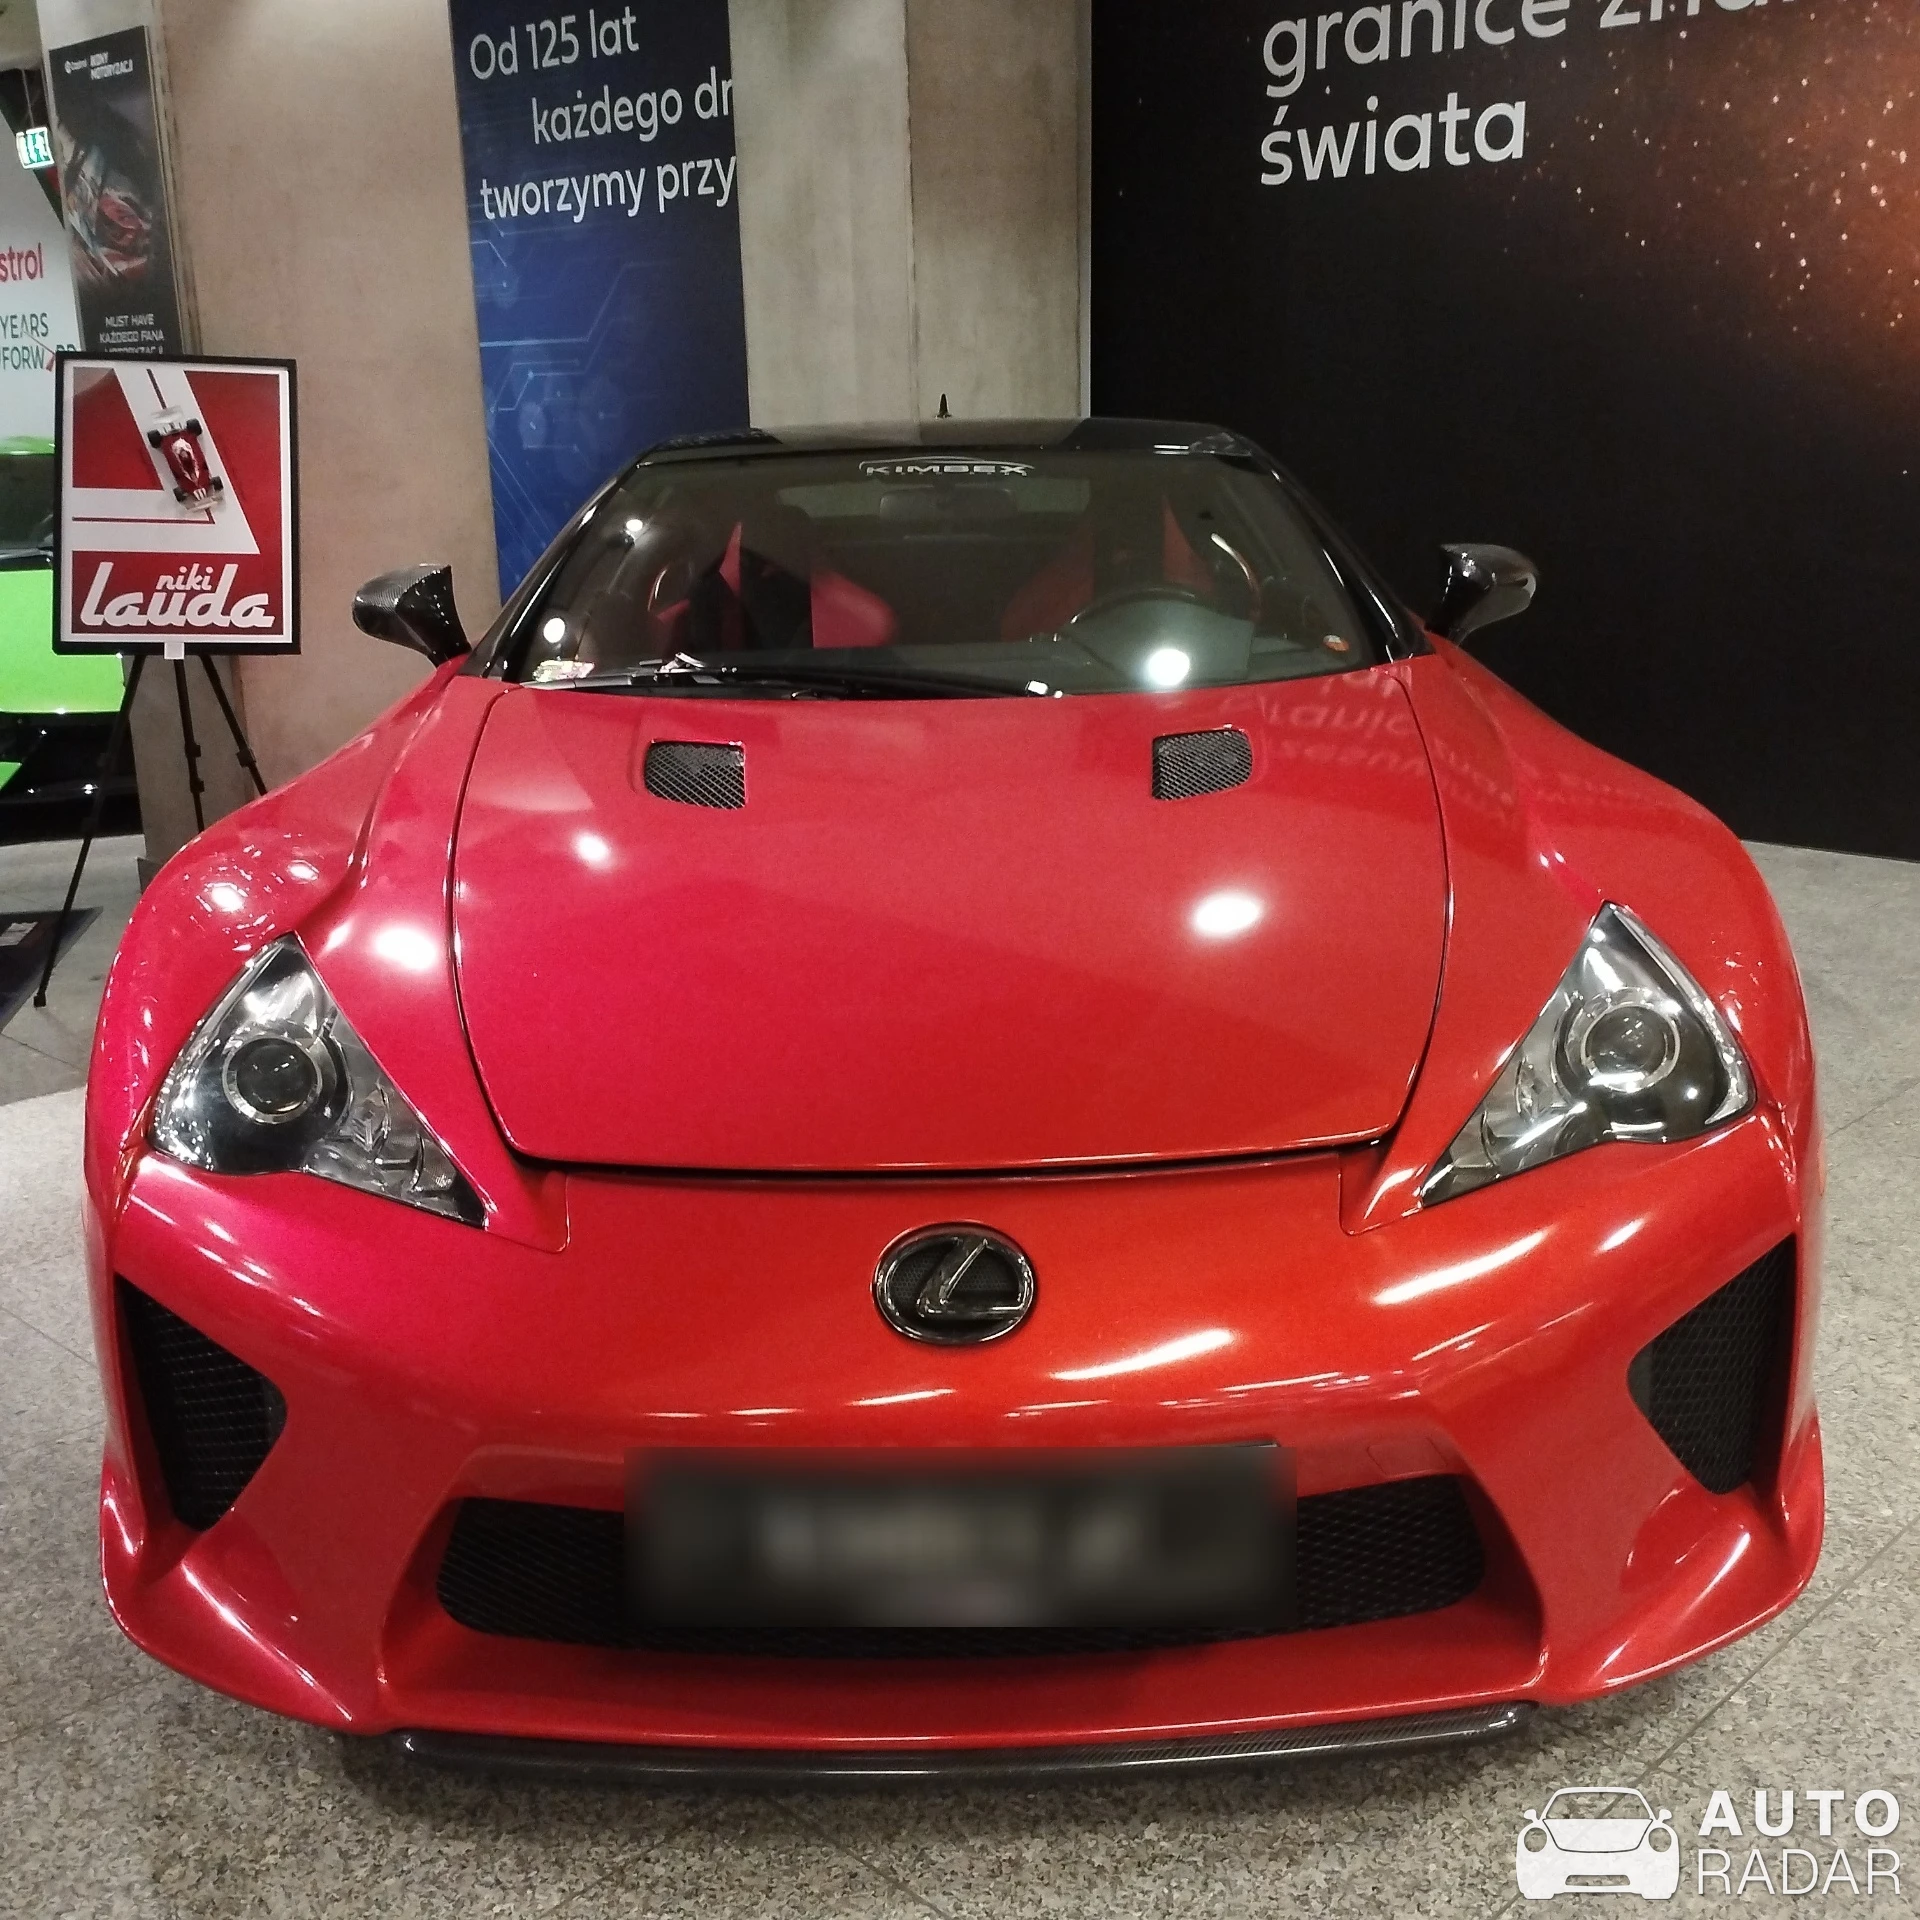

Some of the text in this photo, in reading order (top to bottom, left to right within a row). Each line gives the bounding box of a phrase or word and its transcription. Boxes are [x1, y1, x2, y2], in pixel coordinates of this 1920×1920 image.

[470, 6, 640, 79] Od 125 lat
[1263, 0, 1570, 98] granice
[531, 84, 683, 144] każdego
[1261, 92, 1526, 185] świata
[480, 155, 737, 223] tworzymy przy
[0, 312, 49, 340] YEARS
[105, 313, 154, 327] MUST HAVE
[141, 329, 165, 342] FANA
[80, 561, 275, 628] lauda
[156, 563, 213, 591] niki
